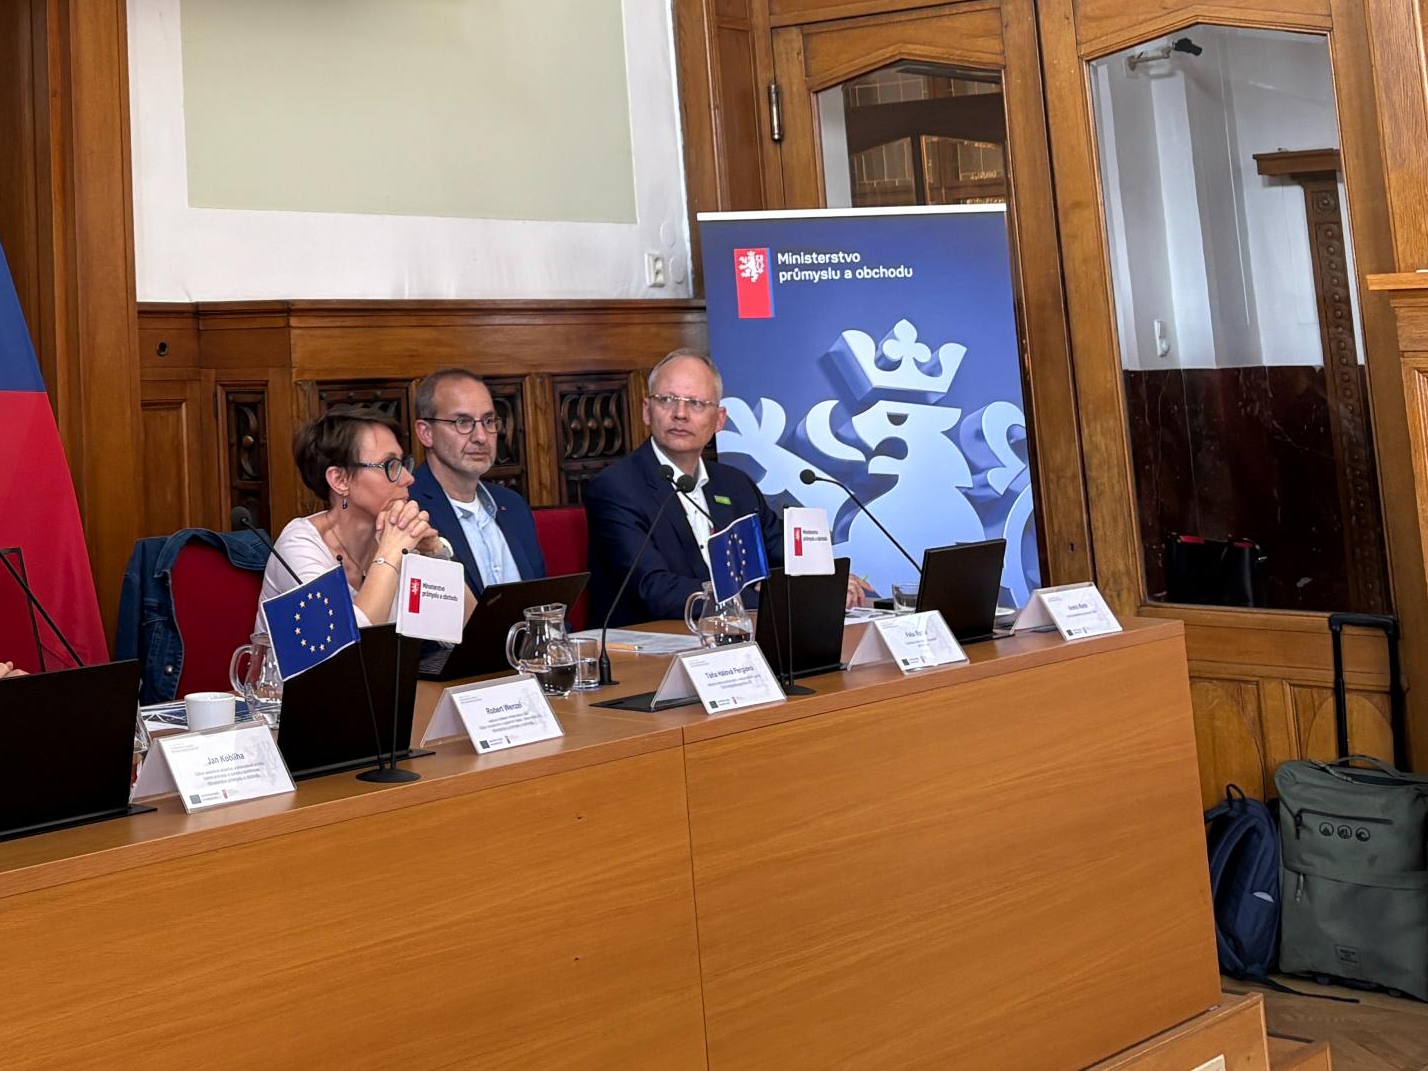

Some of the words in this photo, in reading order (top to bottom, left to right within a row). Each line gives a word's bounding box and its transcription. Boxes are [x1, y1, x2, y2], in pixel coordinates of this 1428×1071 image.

[777, 250, 861, 265] Ministerstvo
[778, 267, 841, 284] průmyslu
[843, 269, 853, 280] a
[855, 265, 914, 279] obchodu
